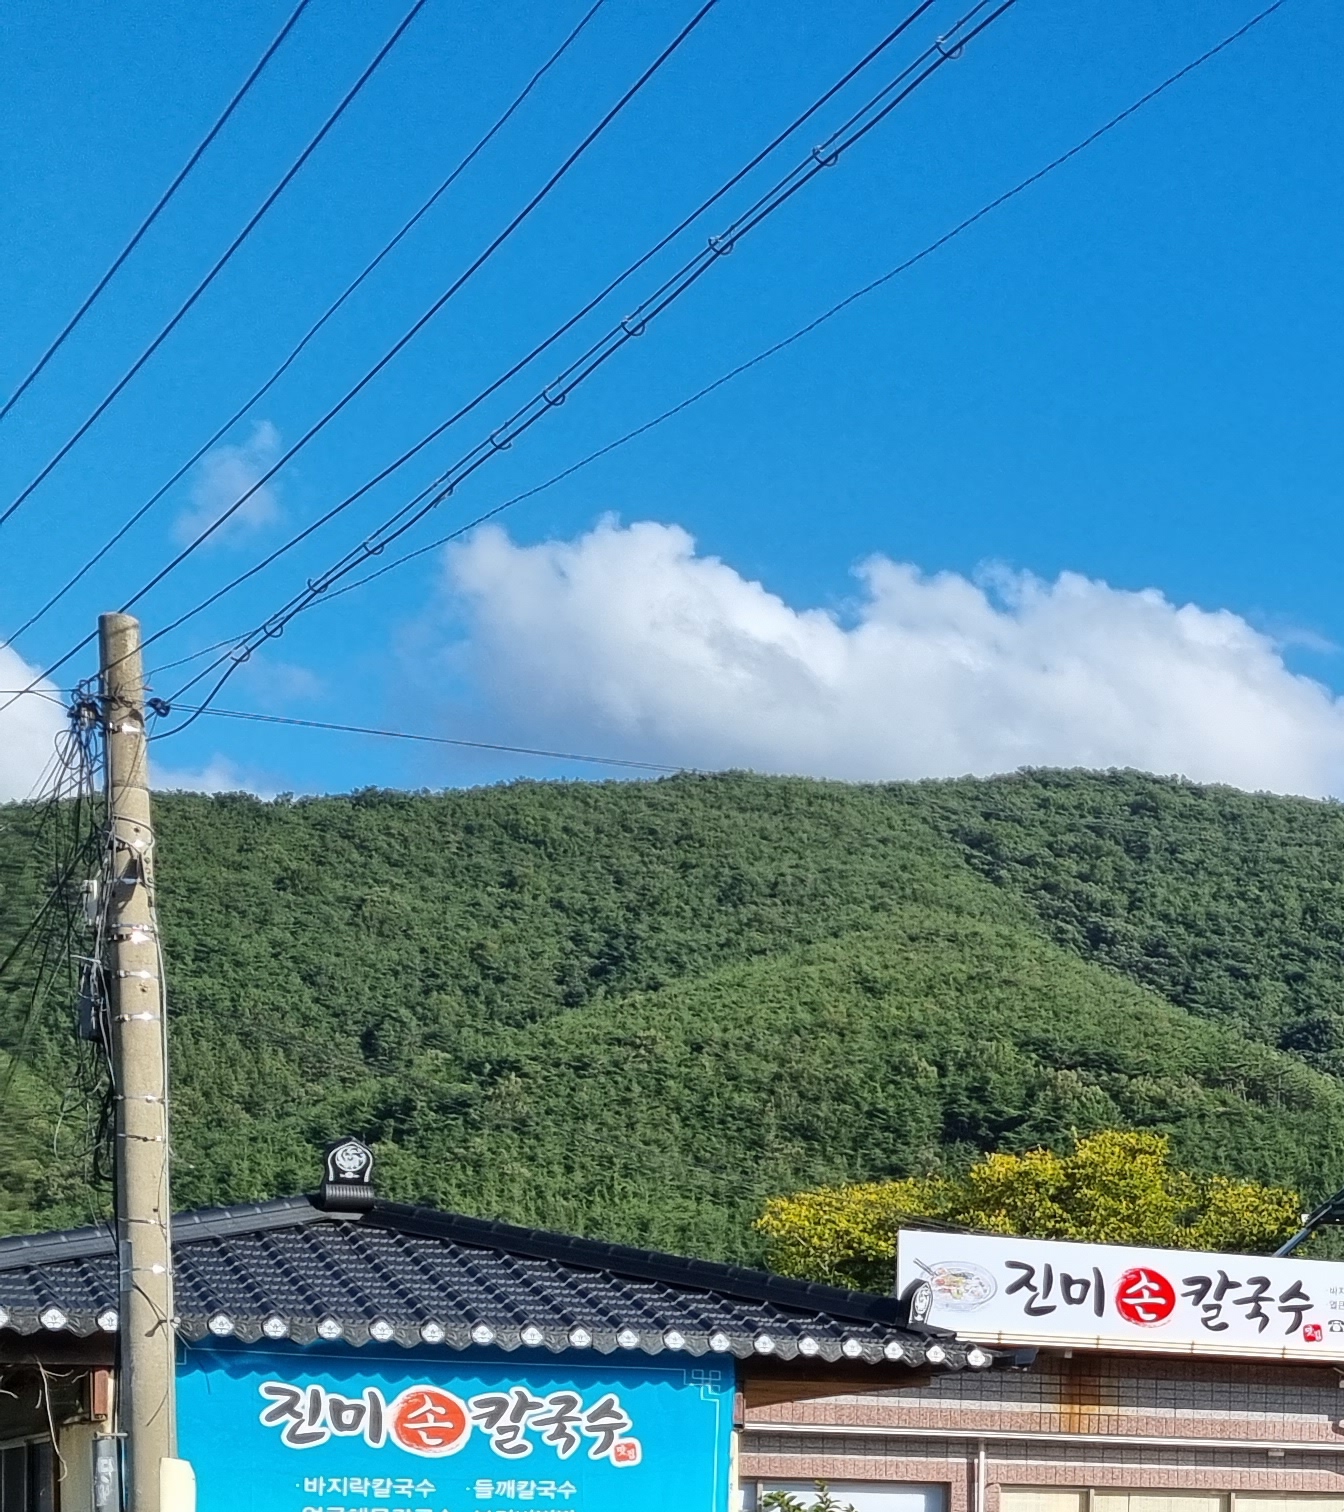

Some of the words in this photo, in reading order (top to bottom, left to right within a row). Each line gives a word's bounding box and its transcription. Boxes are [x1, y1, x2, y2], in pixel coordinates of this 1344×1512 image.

[1004, 1259, 1105, 1317] 진미
[1181, 1269, 1314, 1335] 칼국수
[264, 1385, 383, 1445] 진미
[470, 1388, 627, 1456] 칼국수
[303, 1476, 437, 1498] 바지락칼국수
[473, 1478, 578, 1500] 들깨칼국수
